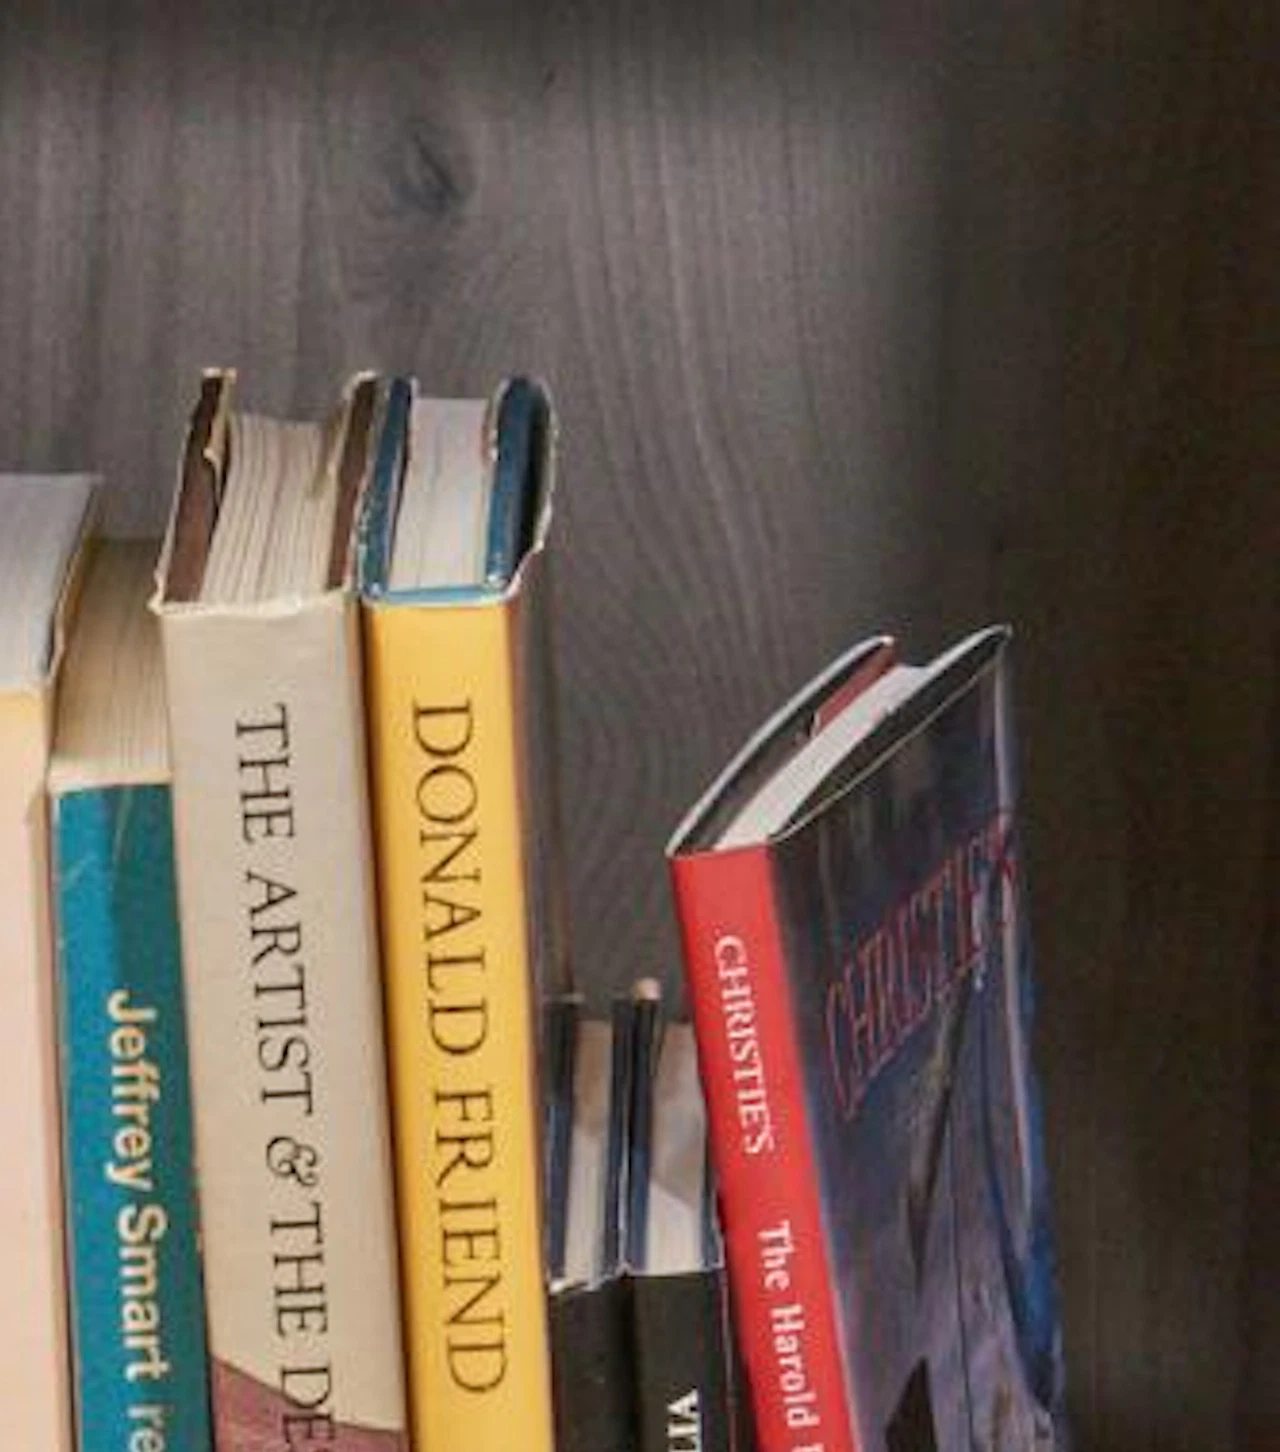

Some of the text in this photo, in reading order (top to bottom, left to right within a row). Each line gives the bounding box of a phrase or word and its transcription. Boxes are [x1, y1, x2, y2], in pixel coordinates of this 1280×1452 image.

[235, 701, 296, 846] THE
[245, 870, 315, 1117] ARTIST
[410, 698, 509, 1396] DONALD FRIEND
[713, 933, 776, 1155] CHRISTIE'S
[102, 987, 161, 1193] Jeffrey
[265, 1135, 320, 1190] &
[115, 1203, 172, 1384] Smart
[268, 1199, 329, 1339] THE
[756, 1217, 794, 1291] The
[770, 1306, 822, 1428] Harold
